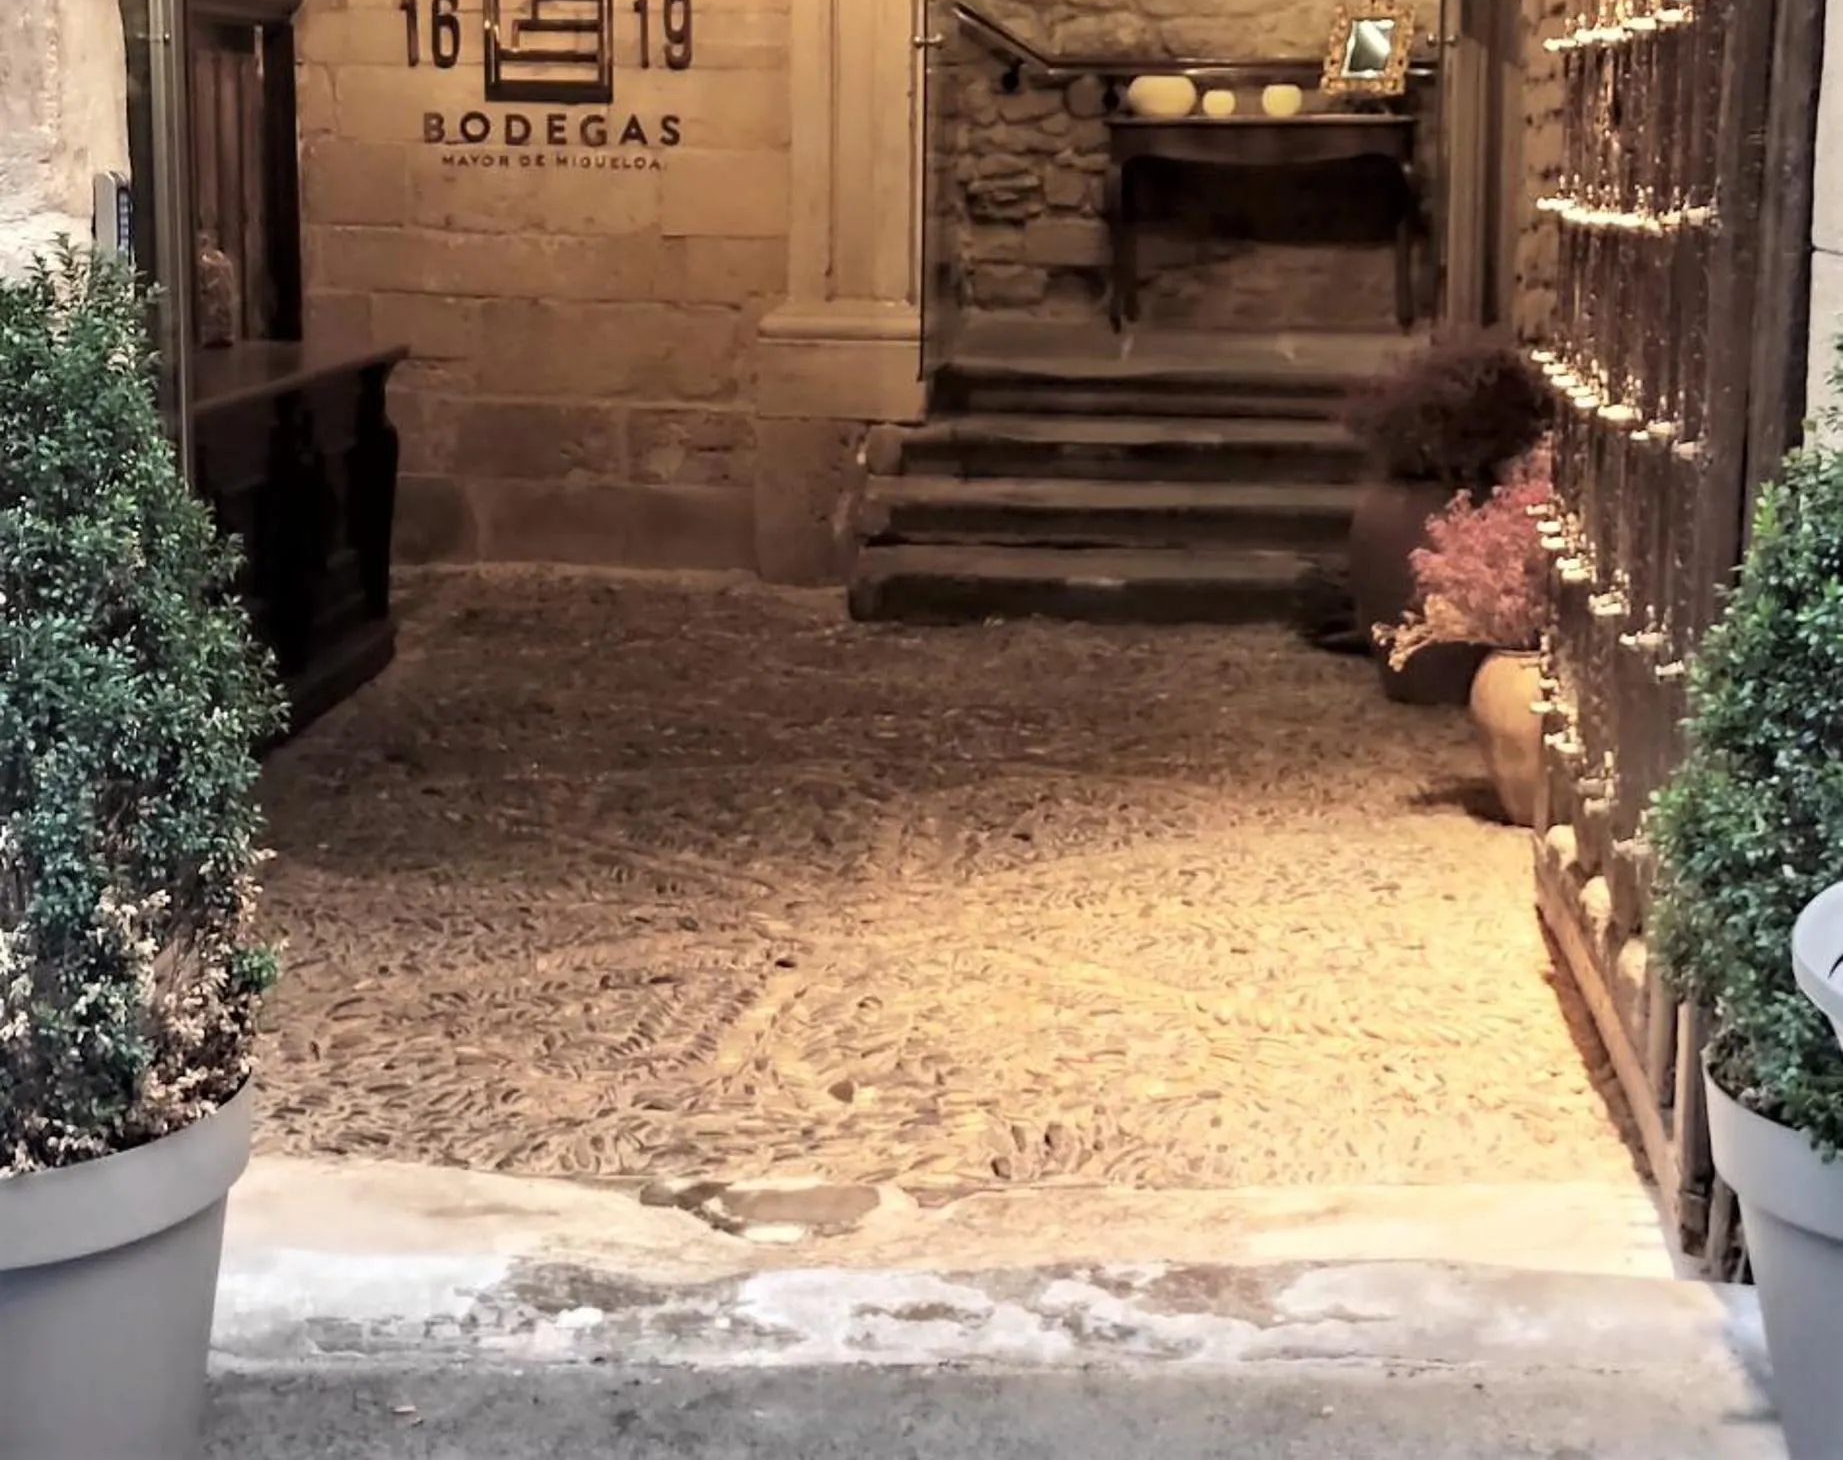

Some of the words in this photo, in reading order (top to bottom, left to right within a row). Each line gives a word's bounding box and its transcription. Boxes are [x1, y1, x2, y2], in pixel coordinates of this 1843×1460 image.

[422, 111, 682, 147] BODEGAS
[441, 154, 510, 169] MAYOR
[518, 154, 546, 168] DE
[555, 154, 662, 172] MIGUELOA
